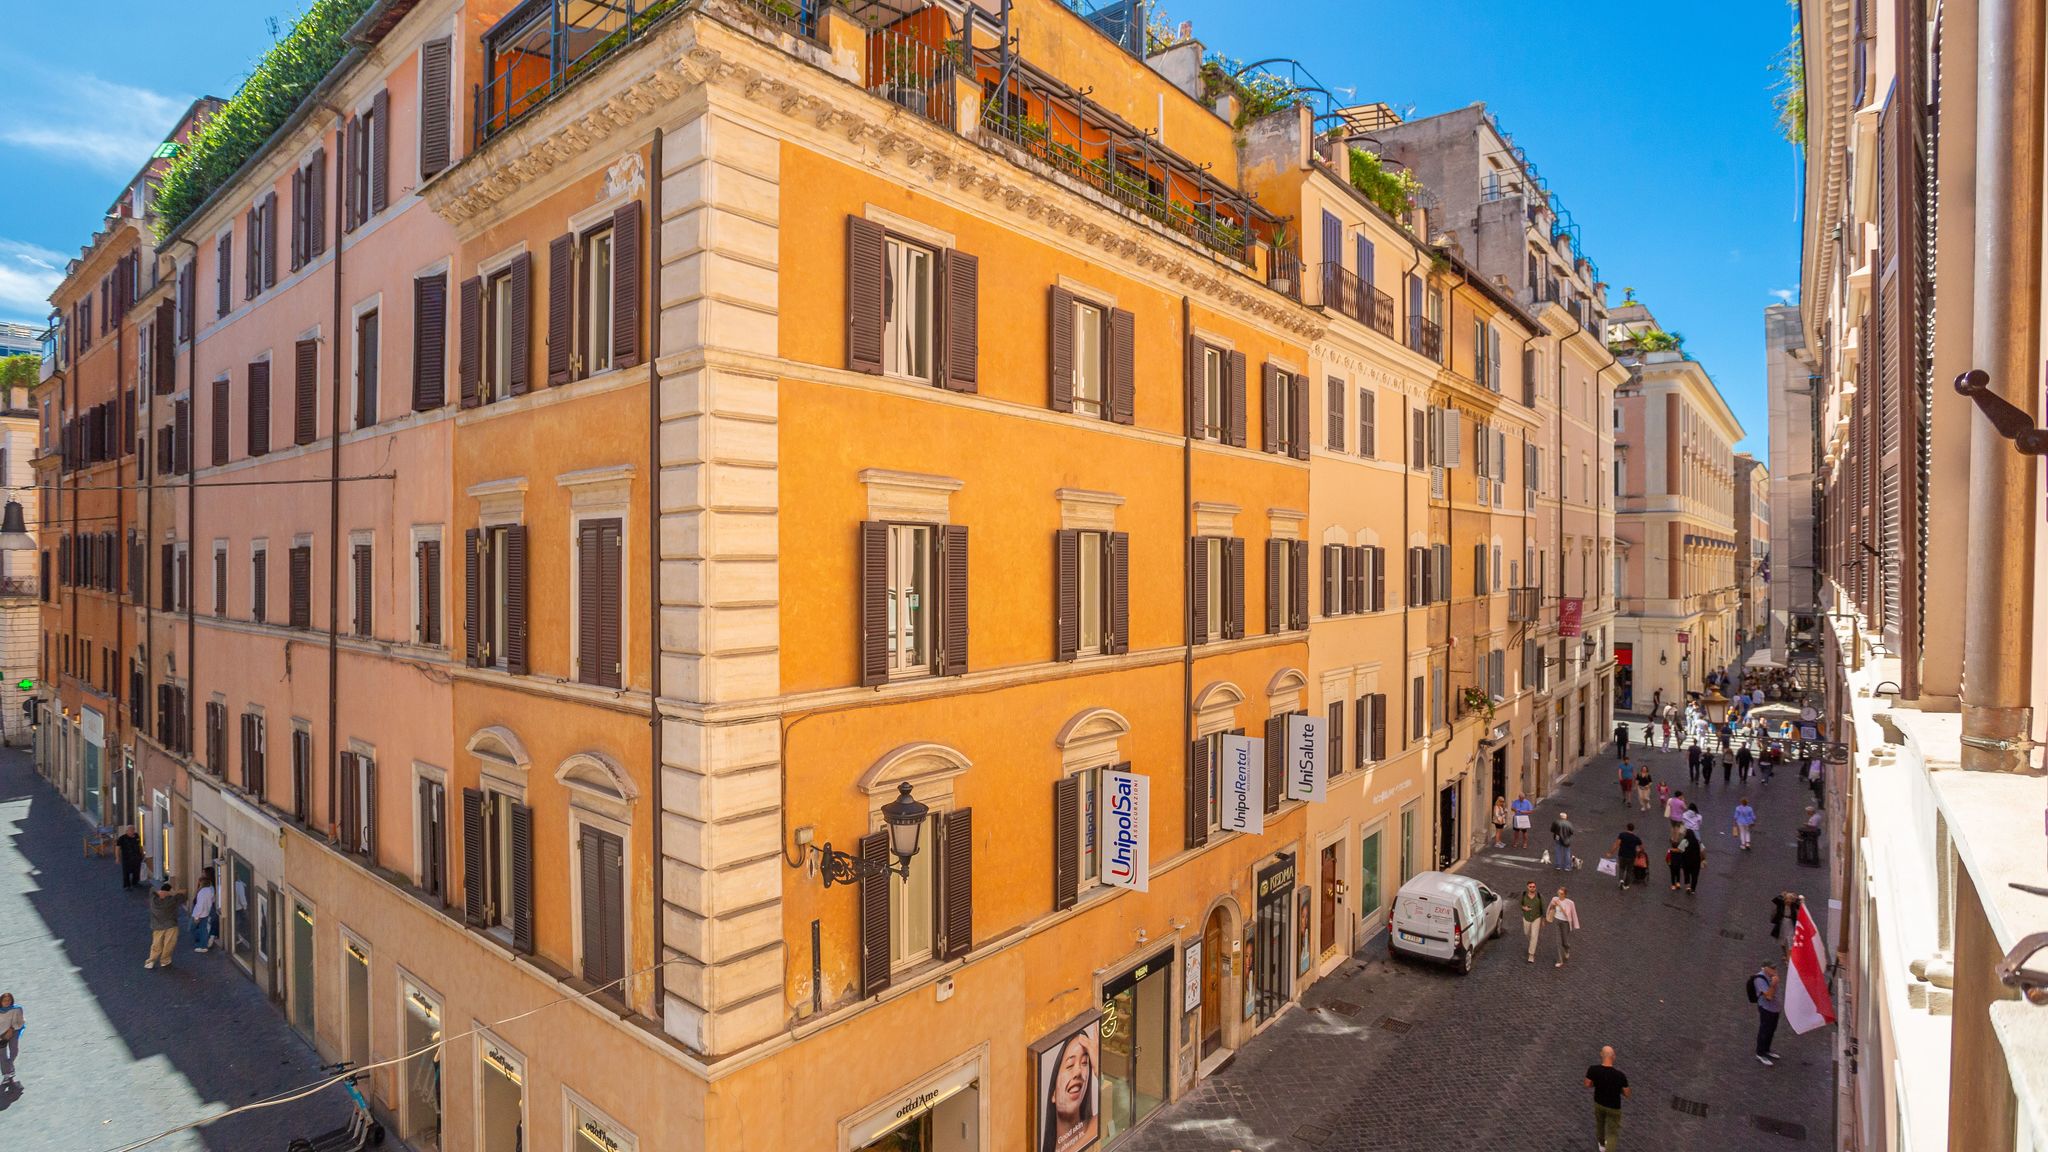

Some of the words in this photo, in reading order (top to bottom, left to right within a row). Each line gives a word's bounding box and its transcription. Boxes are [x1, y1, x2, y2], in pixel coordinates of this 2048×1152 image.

[1234, 748, 1250, 828] UnipolRental
[1298, 723, 1314, 793] UniSalute
[1111, 777, 1137, 877] UnipolSai
[1057, 1128, 1073, 1144] Good
[1072, 1121, 1084, 1134] skin
